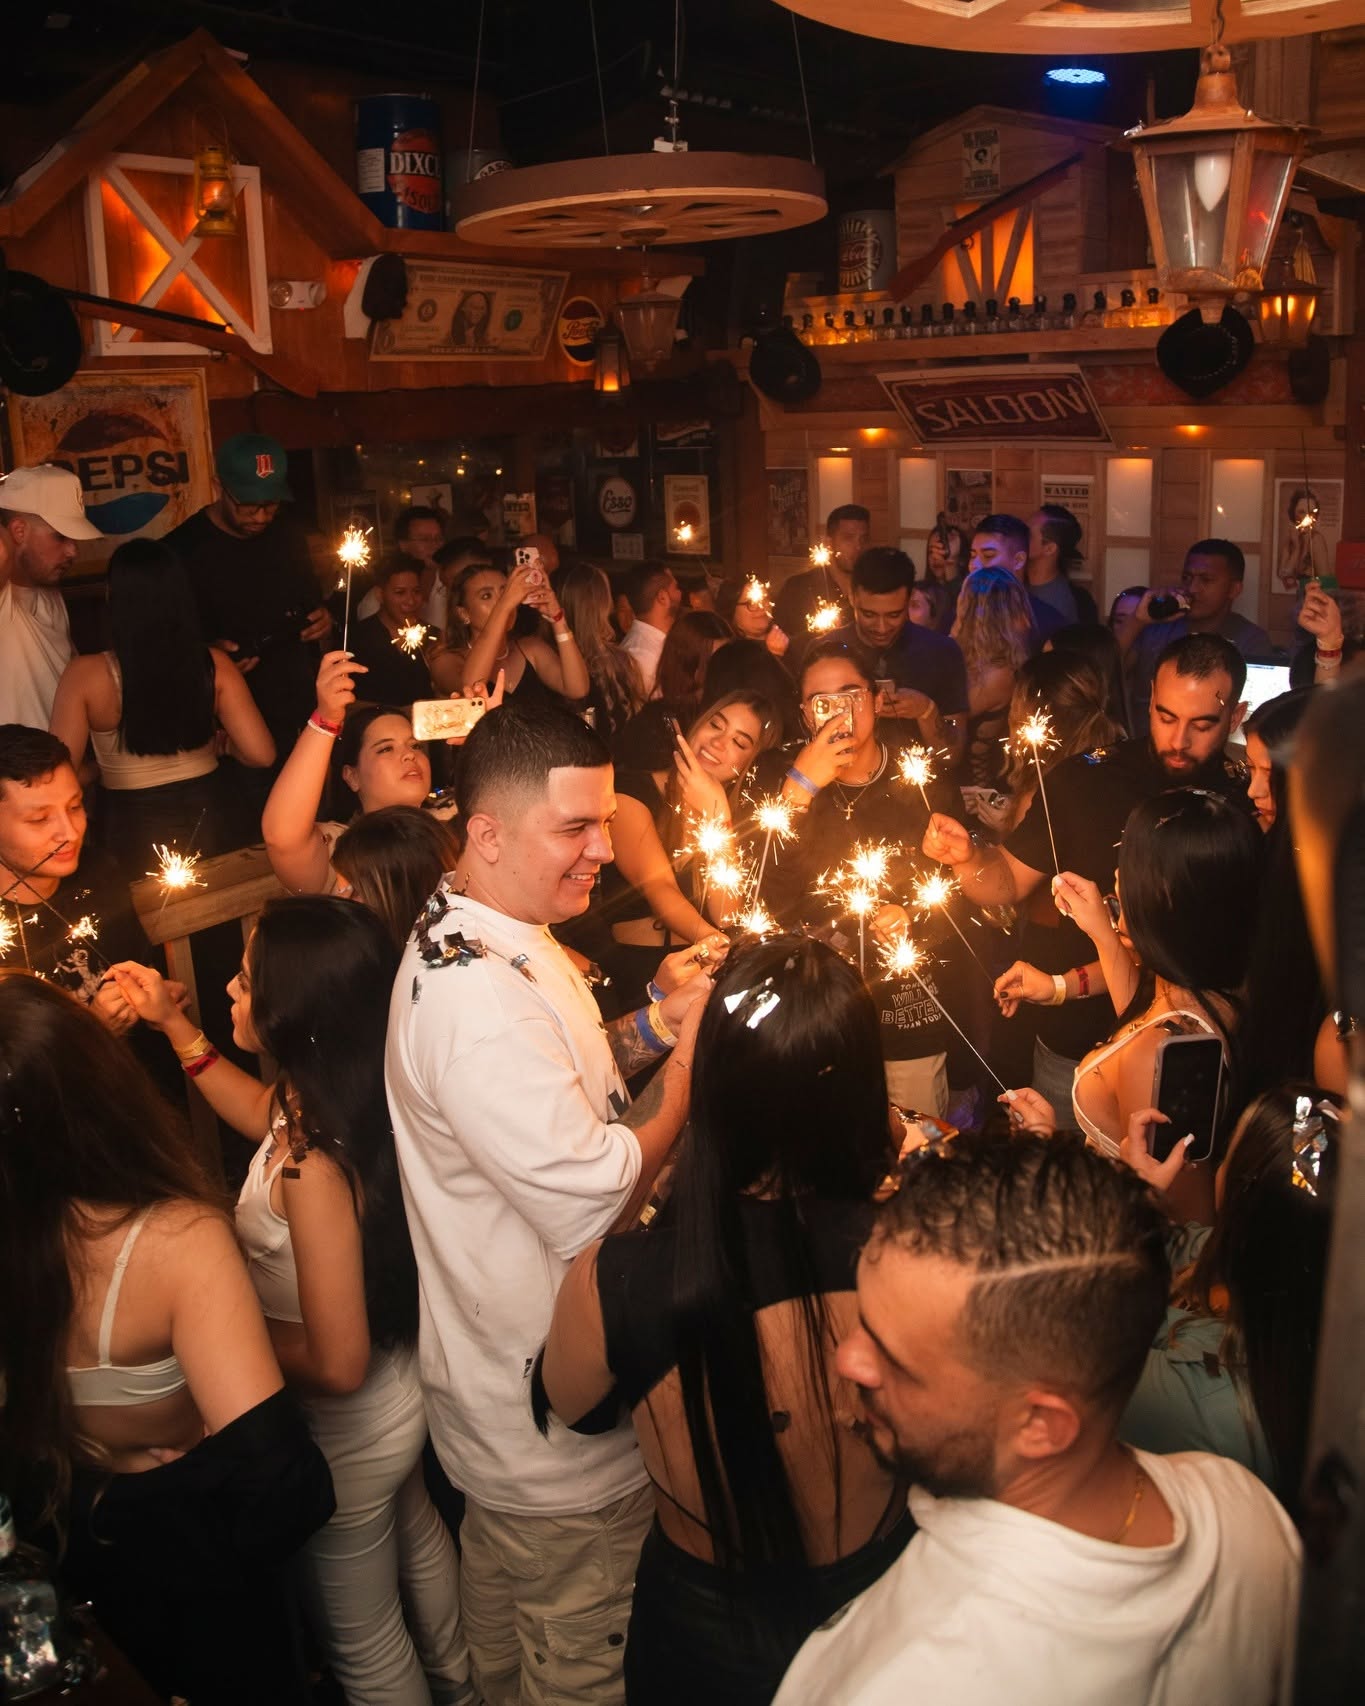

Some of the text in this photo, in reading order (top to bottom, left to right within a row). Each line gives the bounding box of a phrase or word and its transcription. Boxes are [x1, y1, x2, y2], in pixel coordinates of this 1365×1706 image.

[916, 384, 1088, 433] SALOON
[50, 450, 190, 492] EPSI
[602, 489, 633, 513] Esso
[1044, 487, 1089, 496] WANTED
[897, 1013, 942, 1030] THAN TOD
